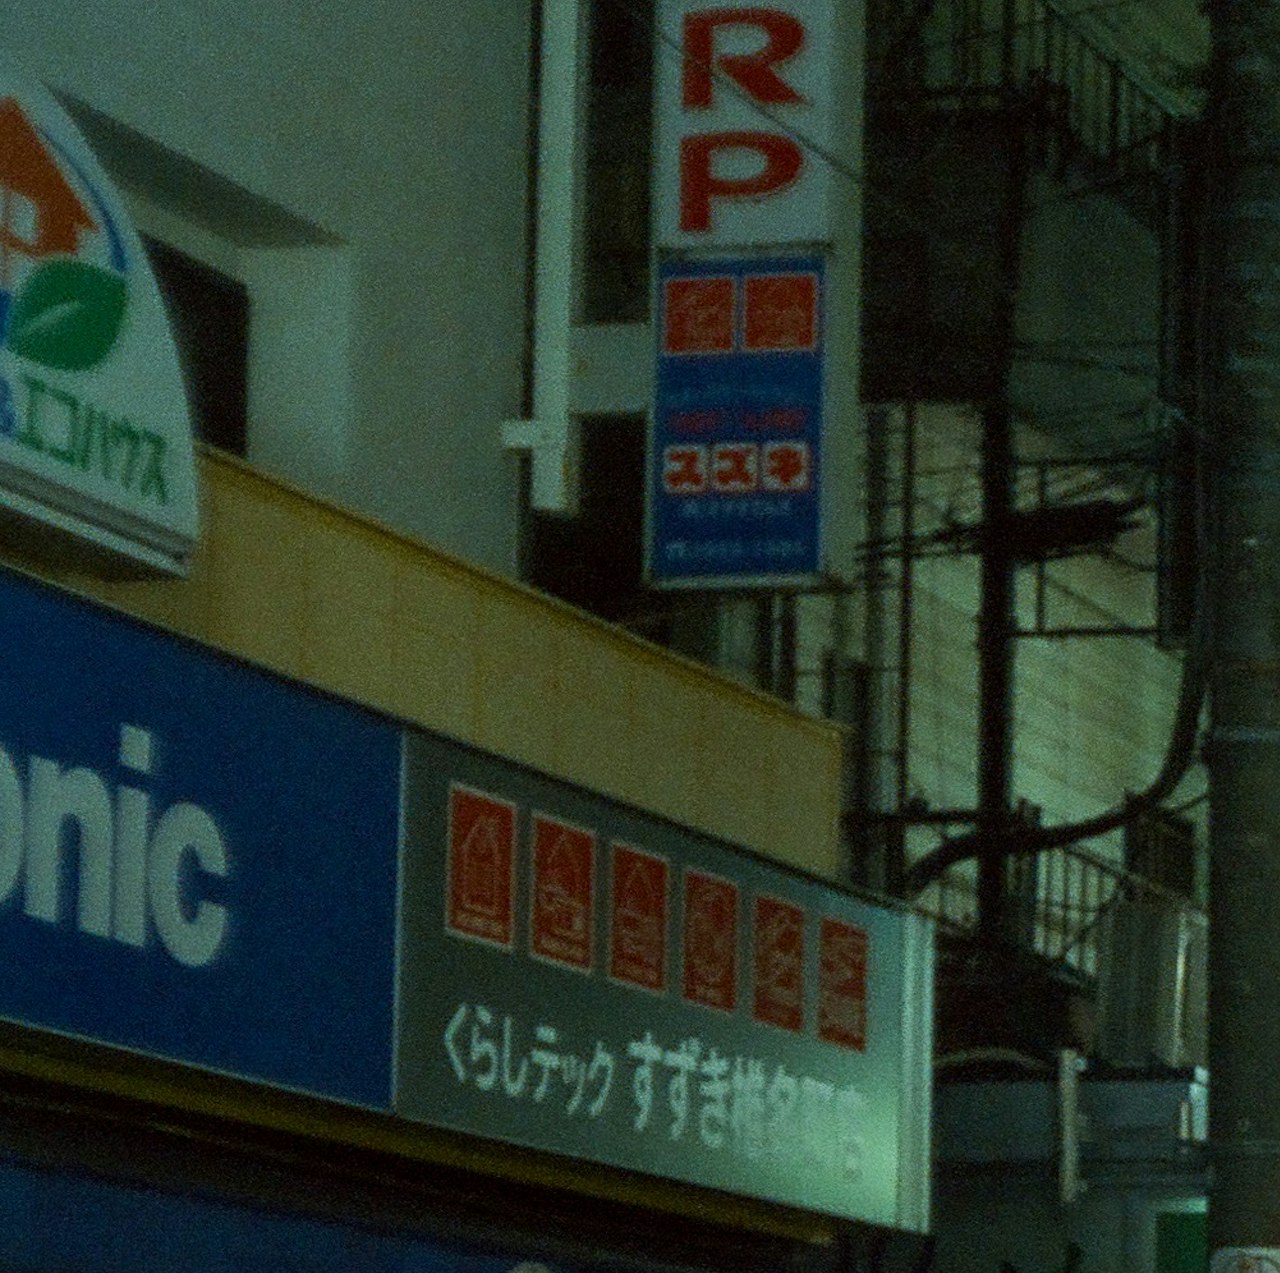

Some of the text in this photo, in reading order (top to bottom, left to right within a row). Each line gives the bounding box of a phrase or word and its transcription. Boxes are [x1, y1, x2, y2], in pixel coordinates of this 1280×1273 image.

[443, 1000, 615, 1118] くらしテック
